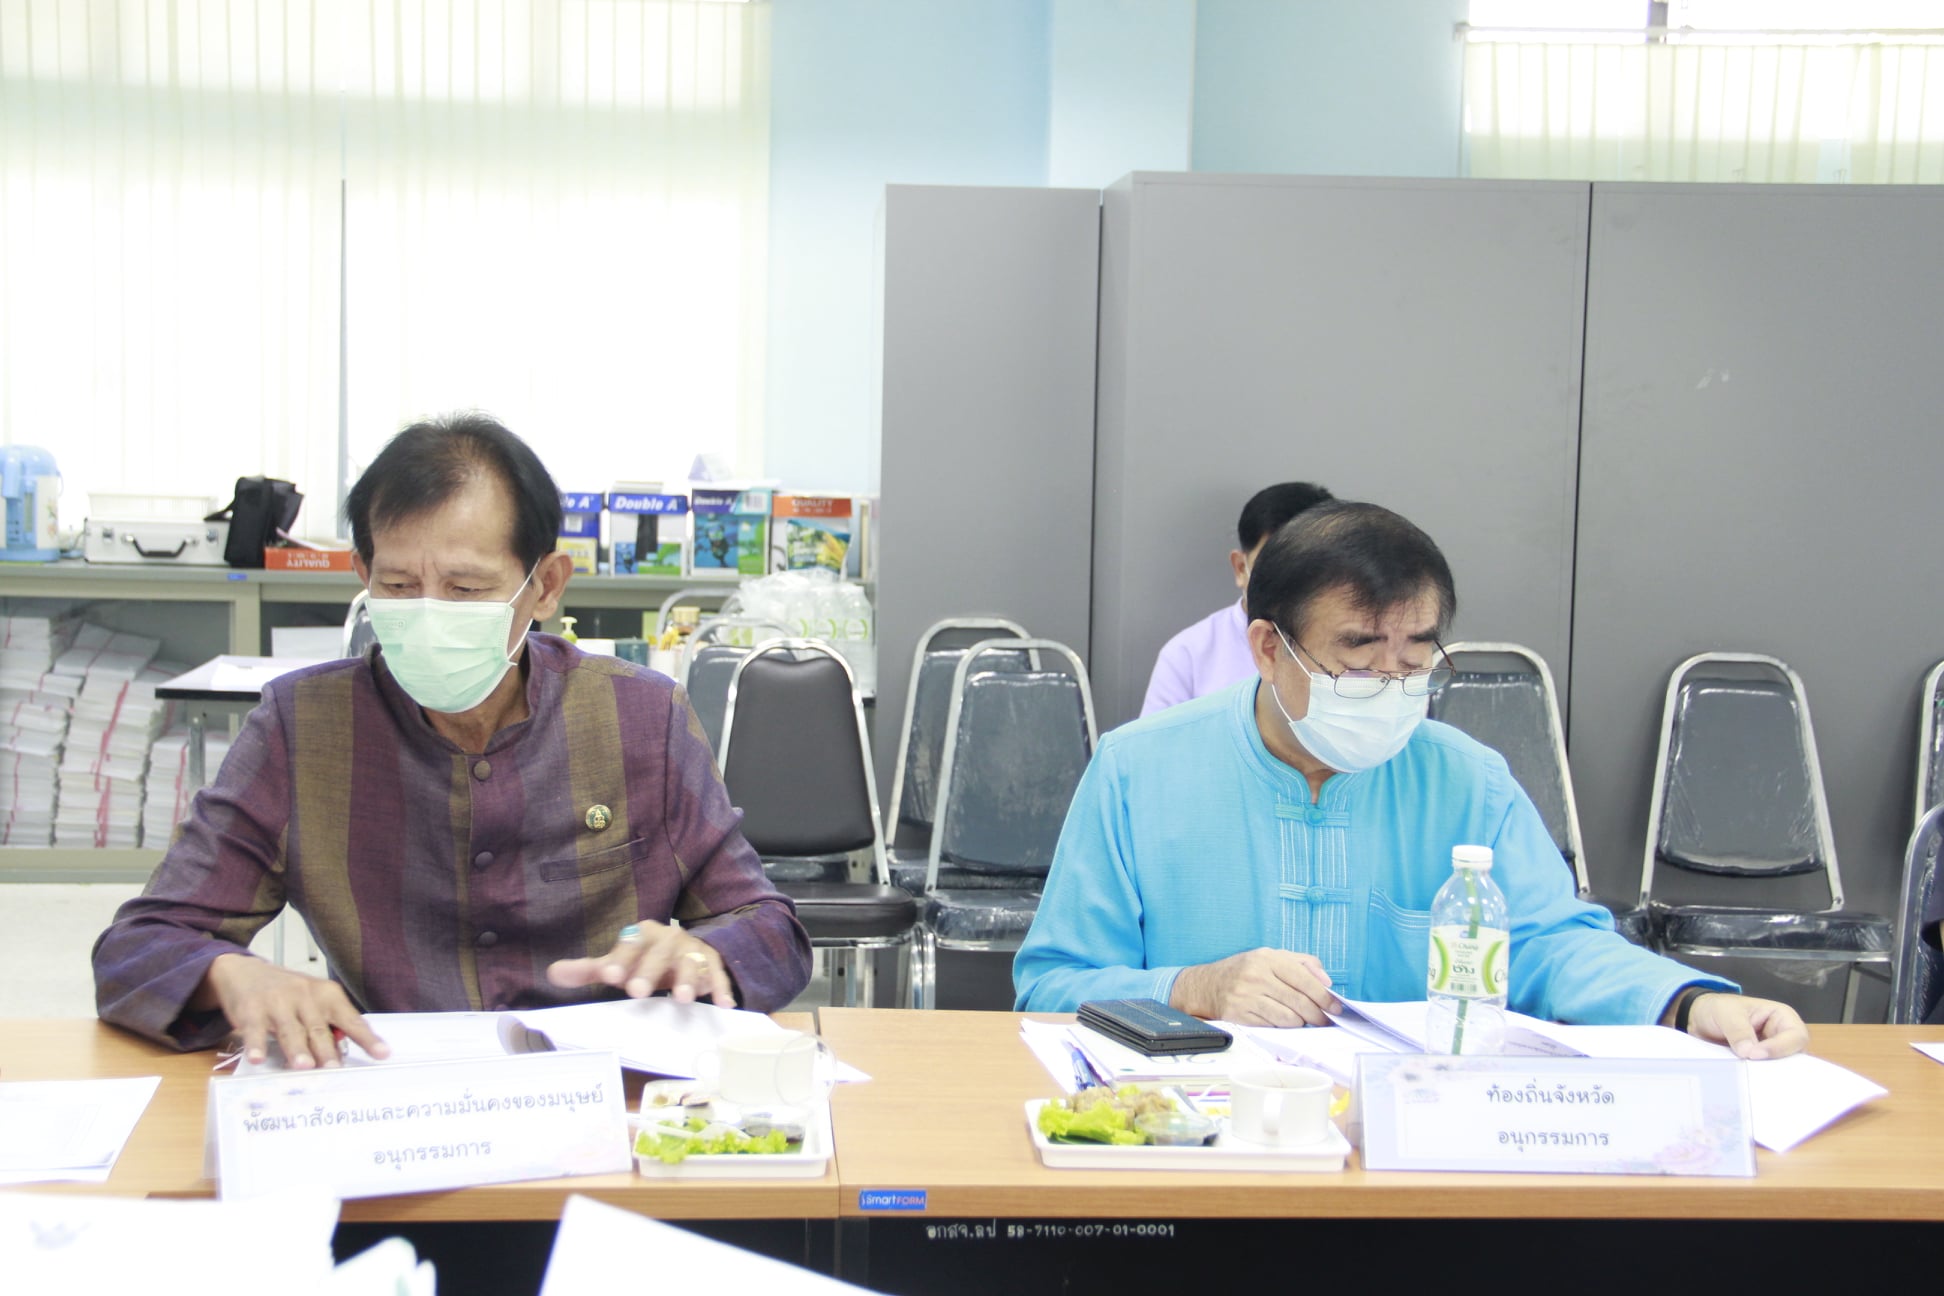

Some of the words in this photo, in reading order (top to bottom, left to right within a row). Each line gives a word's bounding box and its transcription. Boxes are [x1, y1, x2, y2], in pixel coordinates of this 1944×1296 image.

[614, 494, 664, 511] Double
[667, 495, 679, 511] A
[1486, 1077, 1616, 1105] ท้องถิ่นจังหวัด
[243, 1083, 605, 1134] พัฒนาสังคมและความมั่นคงของมนุษย์
[1497, 1128, 1610, 1153] อนุกรรมการ
[373, 1139, 493, 1171] อนุกรรมการ
